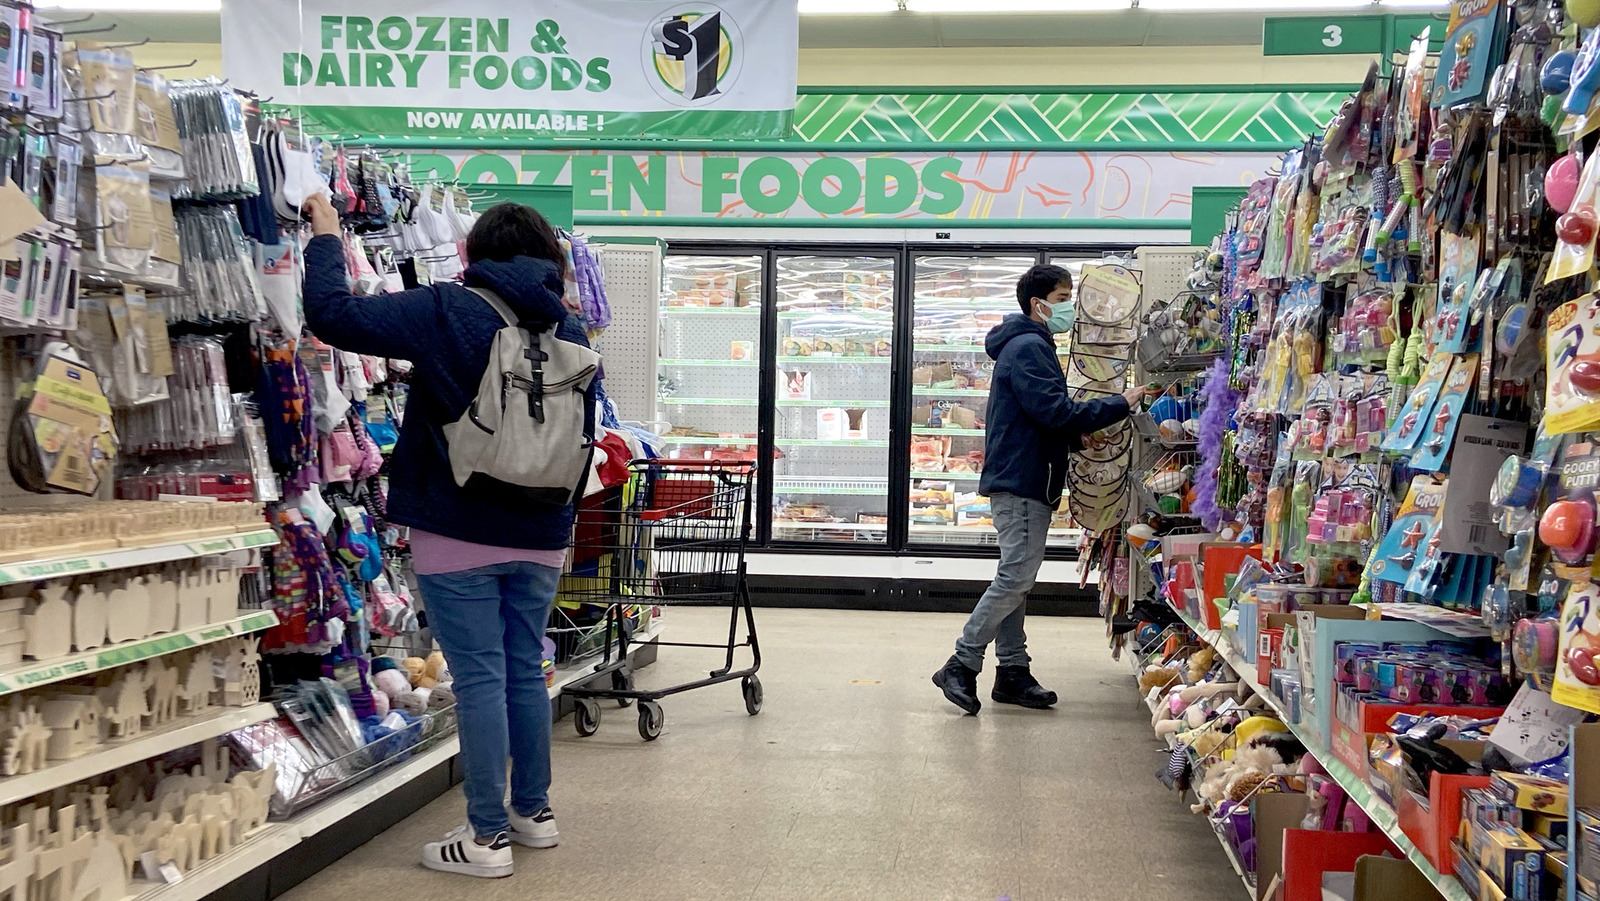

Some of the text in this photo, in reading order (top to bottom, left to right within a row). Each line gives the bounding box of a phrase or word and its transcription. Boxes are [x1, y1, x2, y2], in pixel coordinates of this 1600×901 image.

[320, 15, 570, 55] FROZEN &
[1321, 25, 1343, 47] 3
[282, 51, 612, 92] DAIRY FOODS
[407, 111, 461, 129] NOW
[470, 112, 588, 131] AVAILABLE
[383, 154, 964, 215] ROZEN FOODS
[1563, 457, 1600, 475] GOOEY
[1565, 473, 1600, 488] PUTTY
